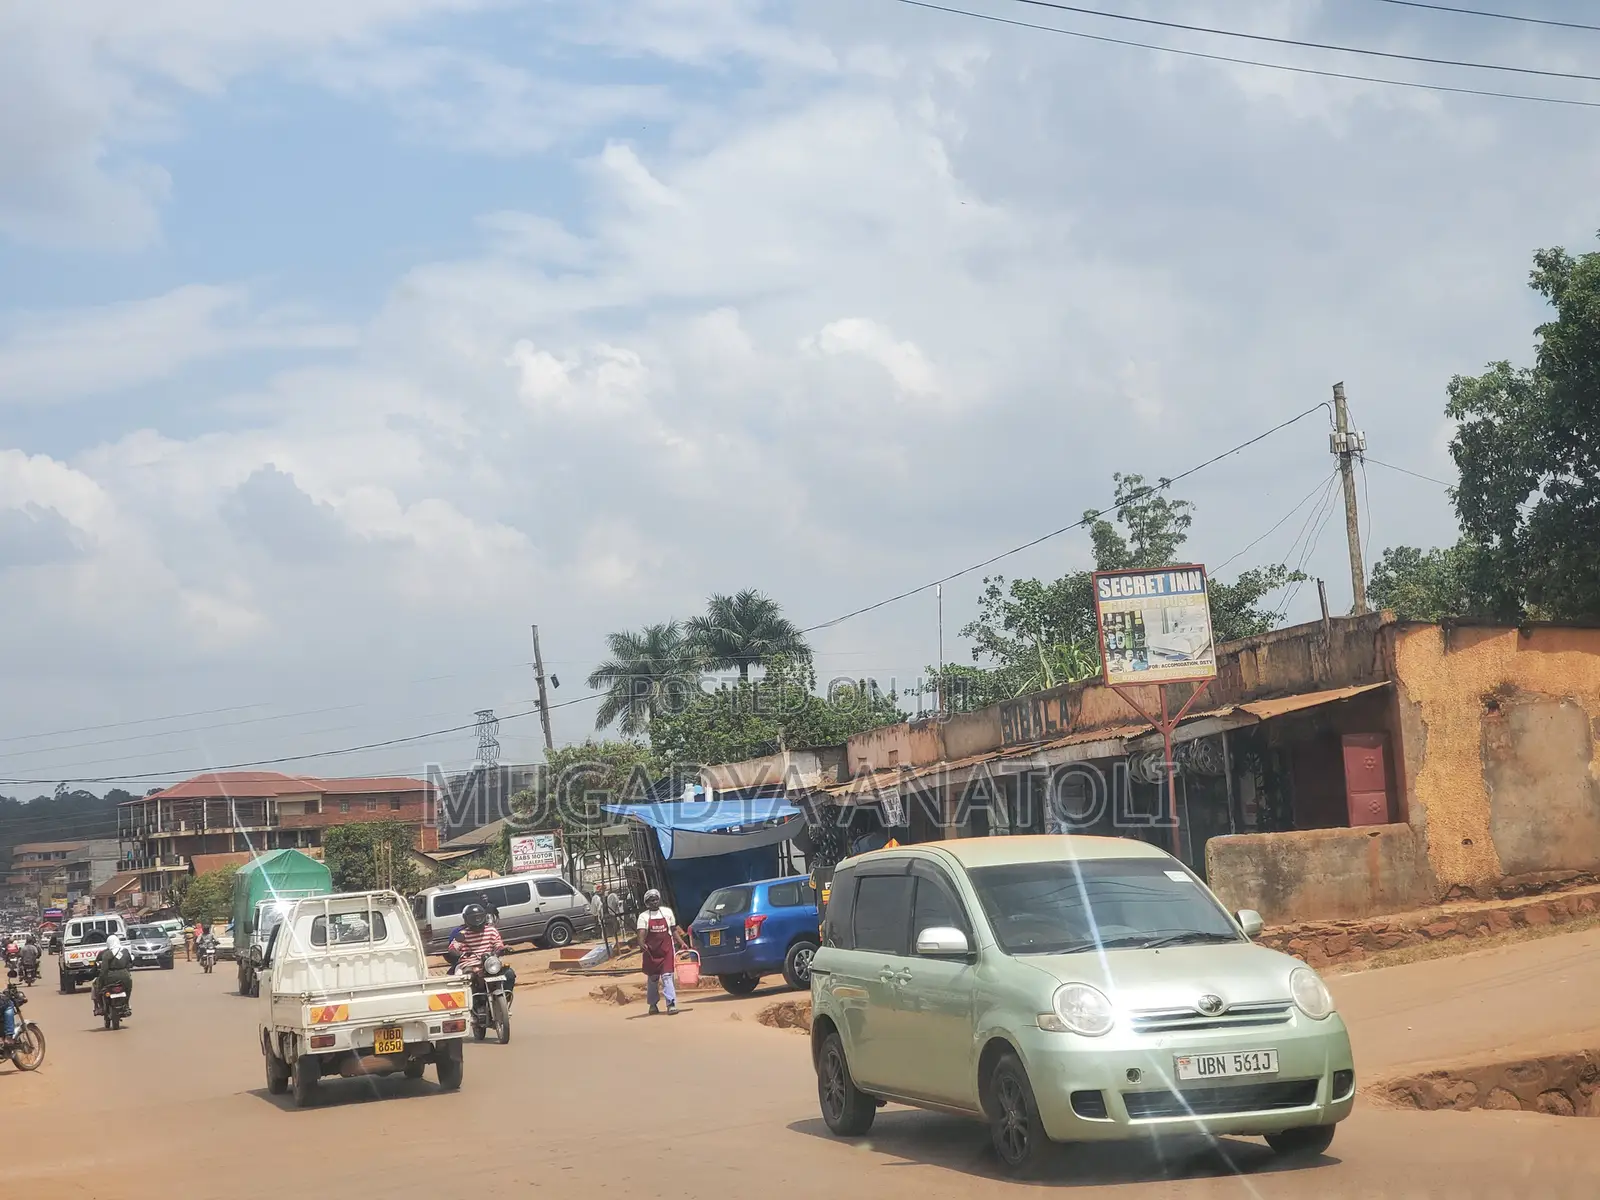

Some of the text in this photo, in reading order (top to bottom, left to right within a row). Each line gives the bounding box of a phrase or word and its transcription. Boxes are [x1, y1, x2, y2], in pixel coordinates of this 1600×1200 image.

[1098, 571, 1202, 597] SECRET INN
[383, 1029, 401, 1040] UBD
[1196, 1053, 1271, 1075] UBN 561J
